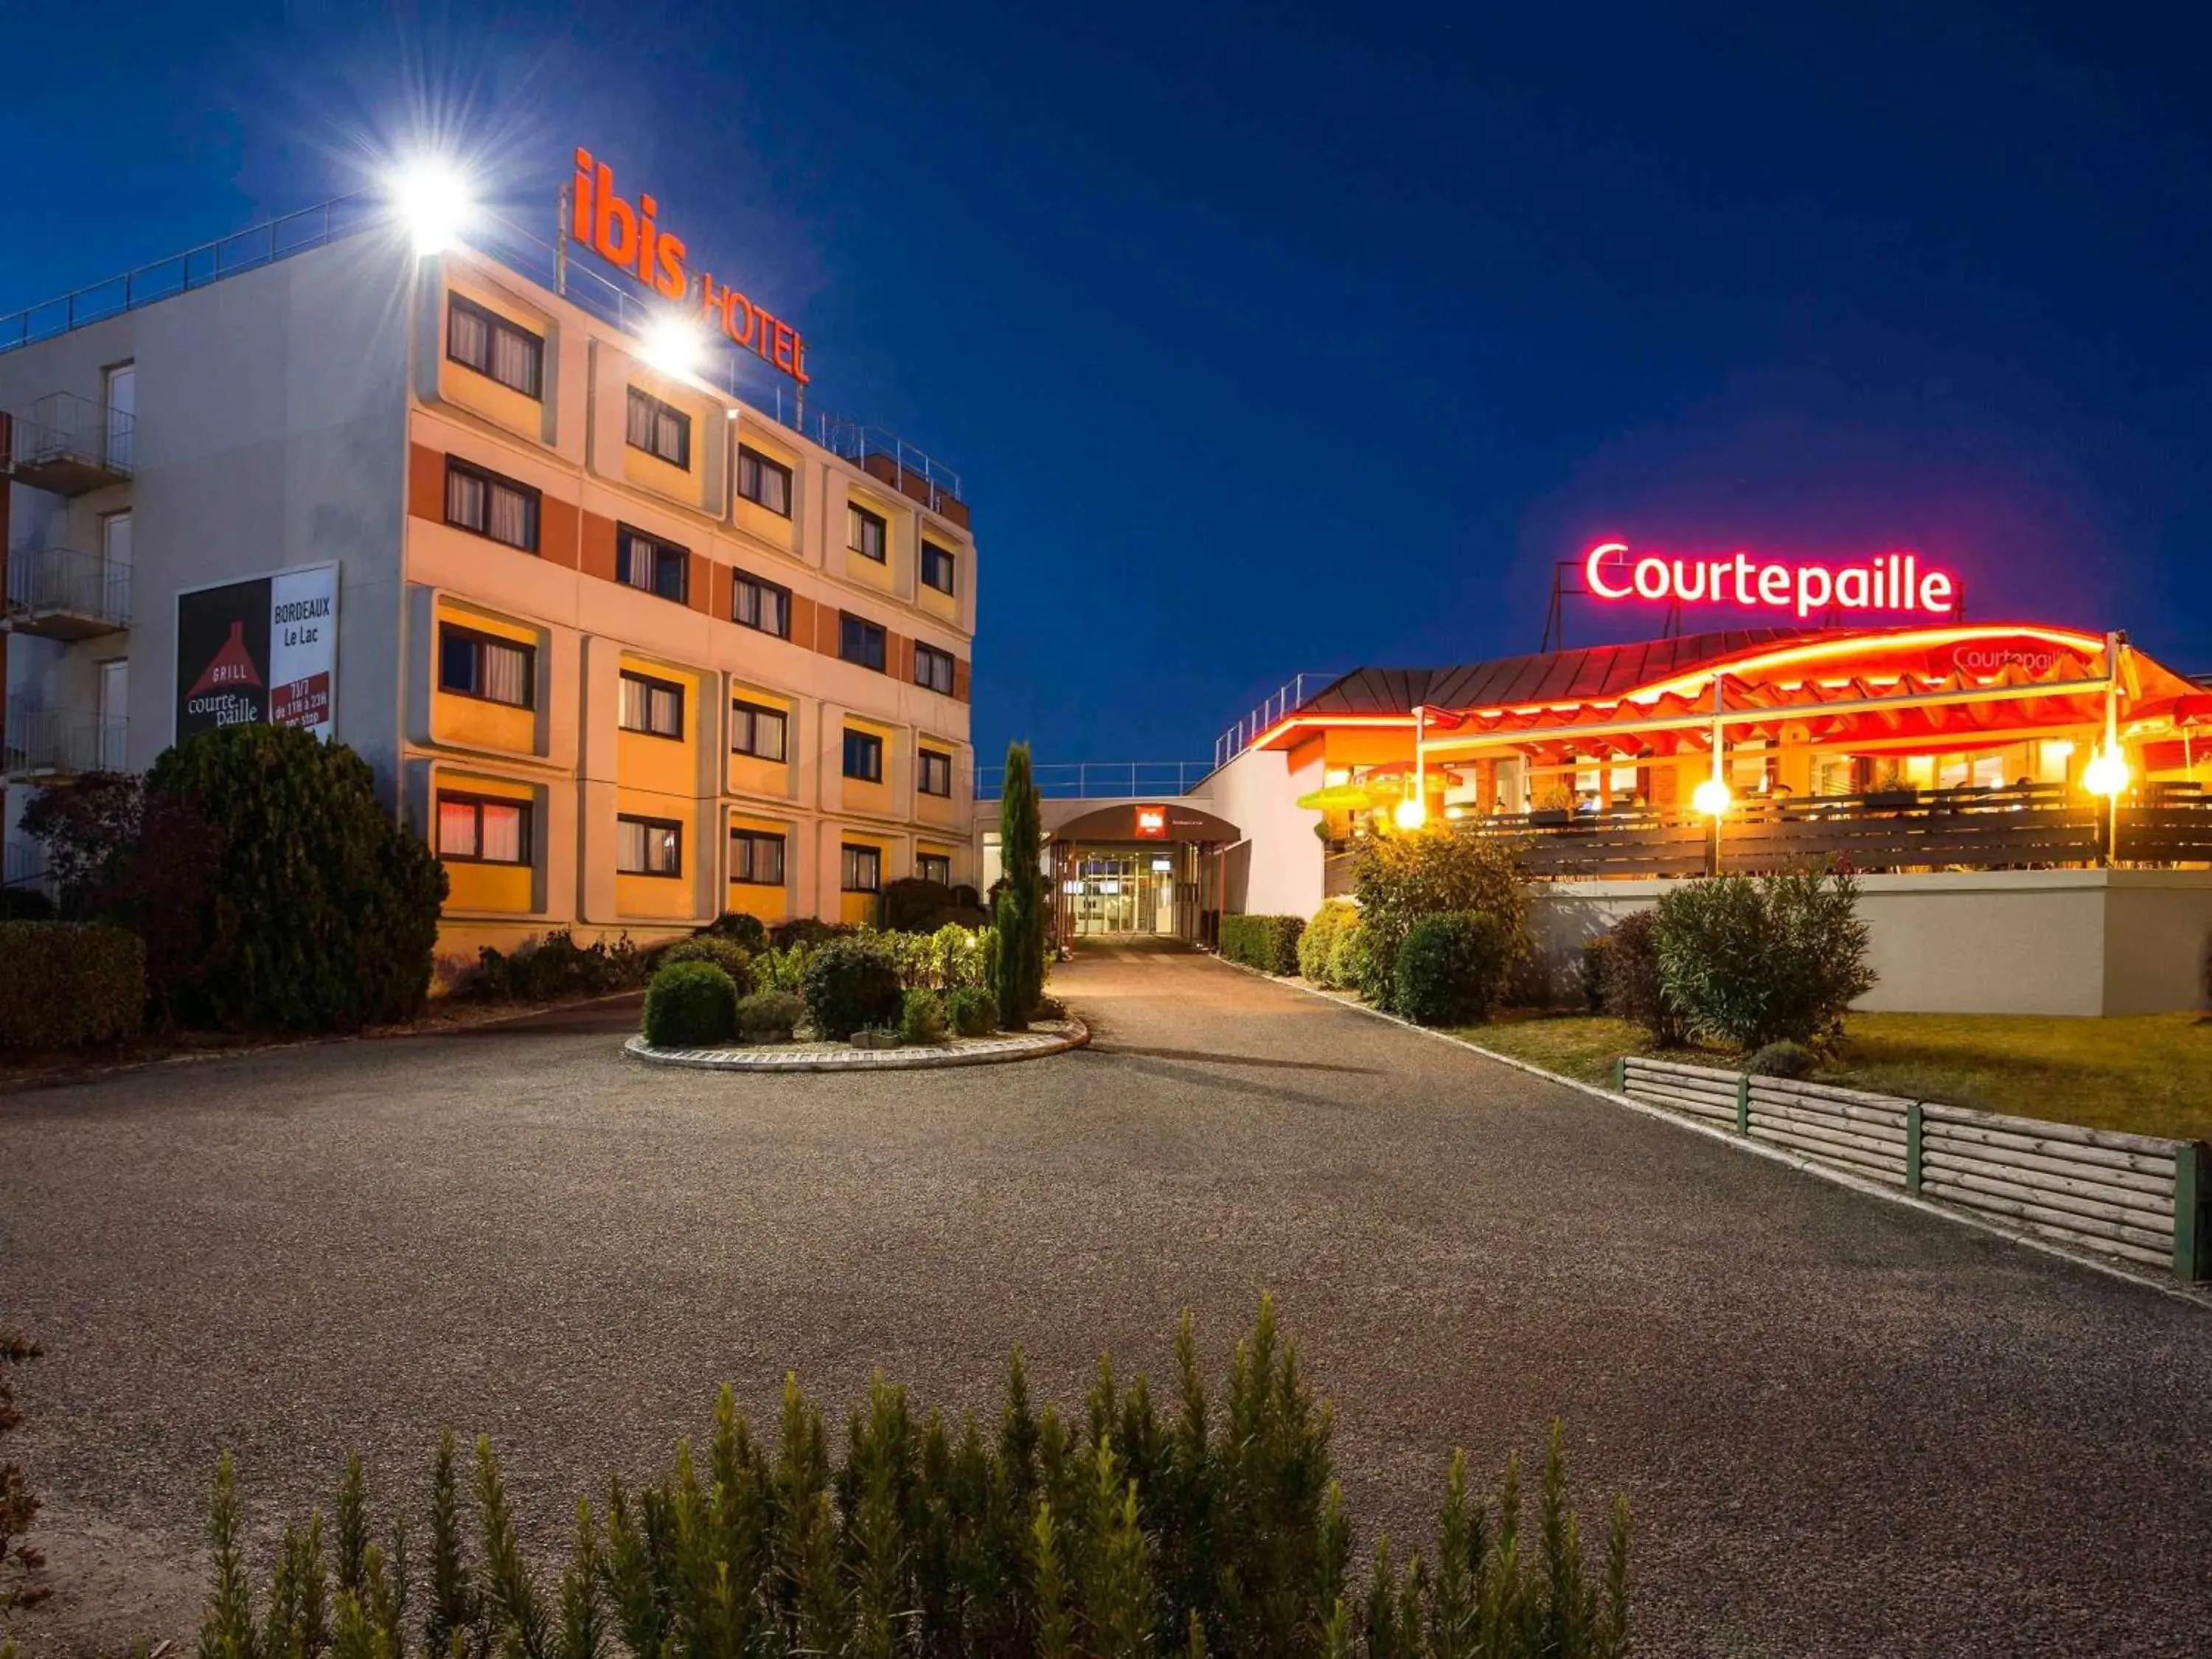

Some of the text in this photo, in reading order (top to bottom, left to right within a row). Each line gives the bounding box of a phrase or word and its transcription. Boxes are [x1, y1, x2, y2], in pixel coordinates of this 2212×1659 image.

[572, 147, 810, 385] ibis HOTEL
[1586, 543, 1952, 617] Courtepaille
[274, 597, 330, 625] BORDEAUX
[284, 627, 319, 647] Le Lac
[1952, 647, 2061, 669] Courtepail
[213, 664, 247, 683] GRILL
[188, 693, 236, 714] courte
[217, 698, 258, 729] paille
[275, 705, 285, 720] de
